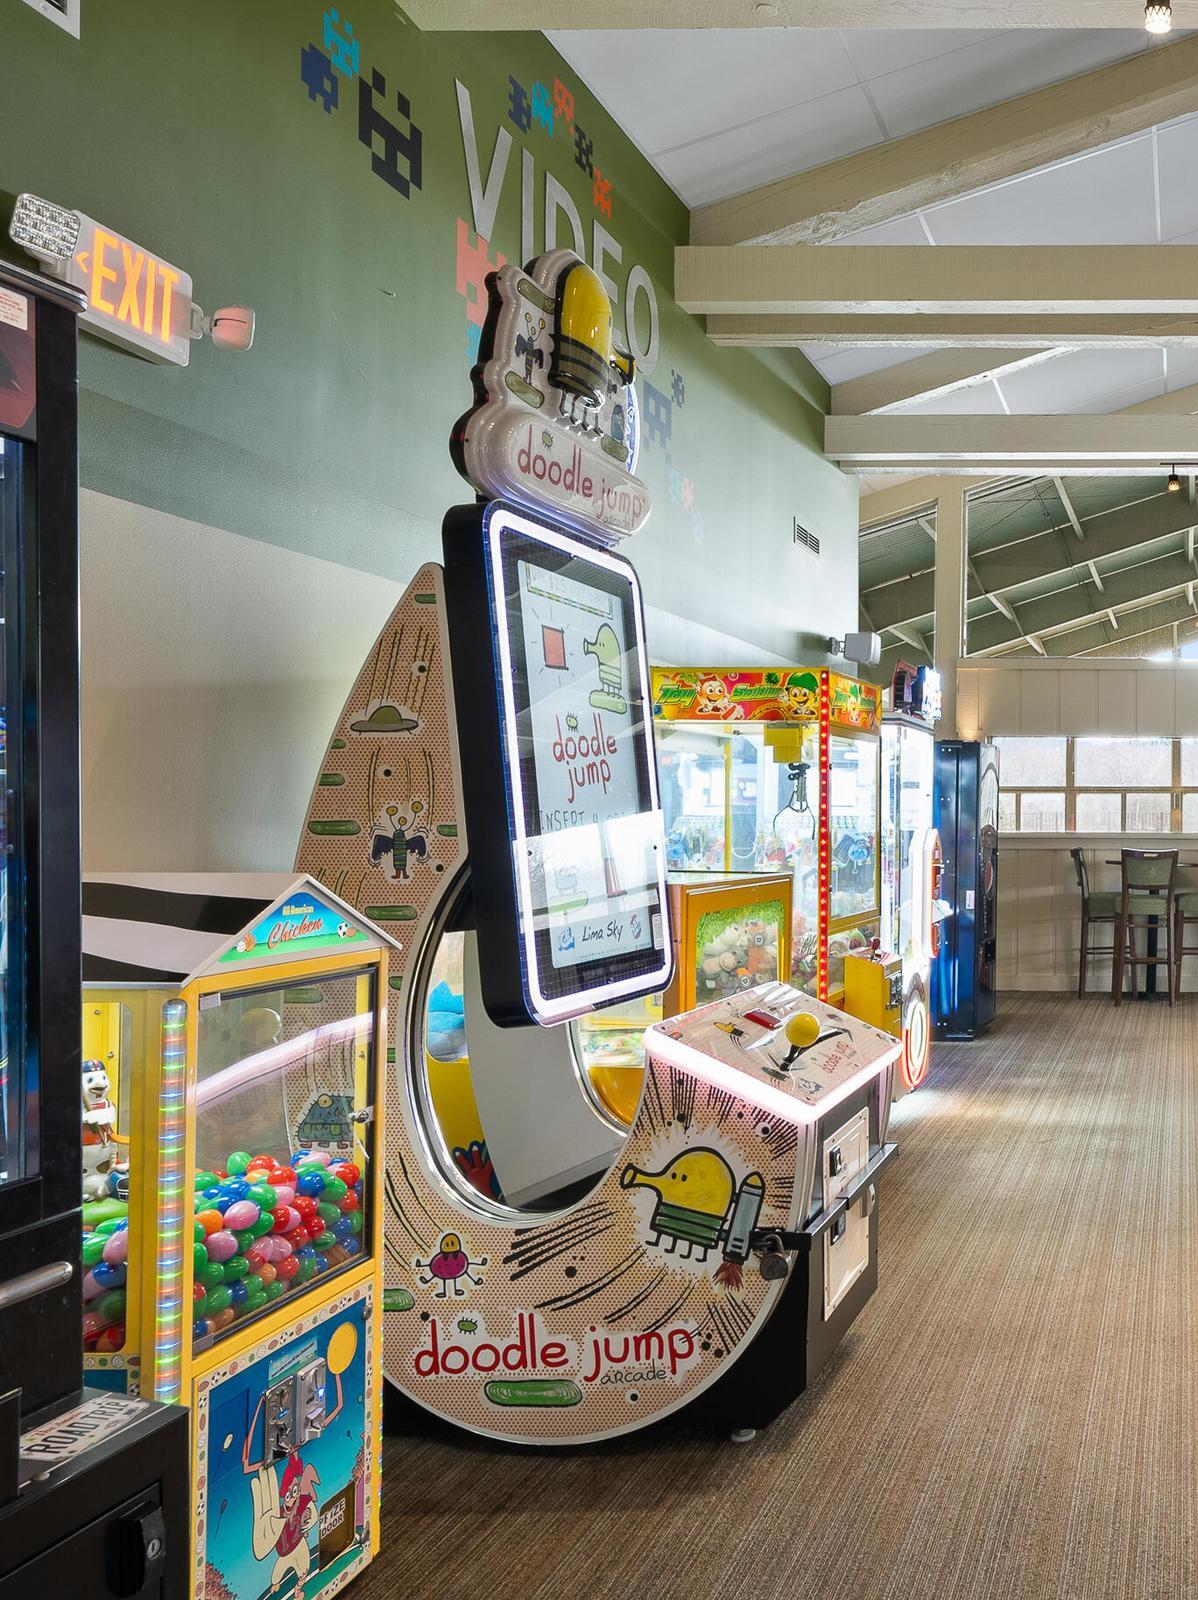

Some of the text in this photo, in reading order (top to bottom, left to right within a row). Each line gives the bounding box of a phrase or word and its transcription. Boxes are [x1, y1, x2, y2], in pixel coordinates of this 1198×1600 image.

[91, 228, 180, 344] EXIT
[517, 424, 643, 528] doodle jump
[656, 683, 697, 709] Toy
[552, 711, 618, 762] doodle
[567, 758, 611, 804] jump
[268, 914, 323, 950] Chicken
[581, 919, 624, 942] Lima Sky
[414, 1312, 694, 1382] doodle jump
[24, 1415, 99, 1455] ROAD
[81, 1400, 131, 1421] TRIP
[321, 1513, 344, 1538] DOOR
